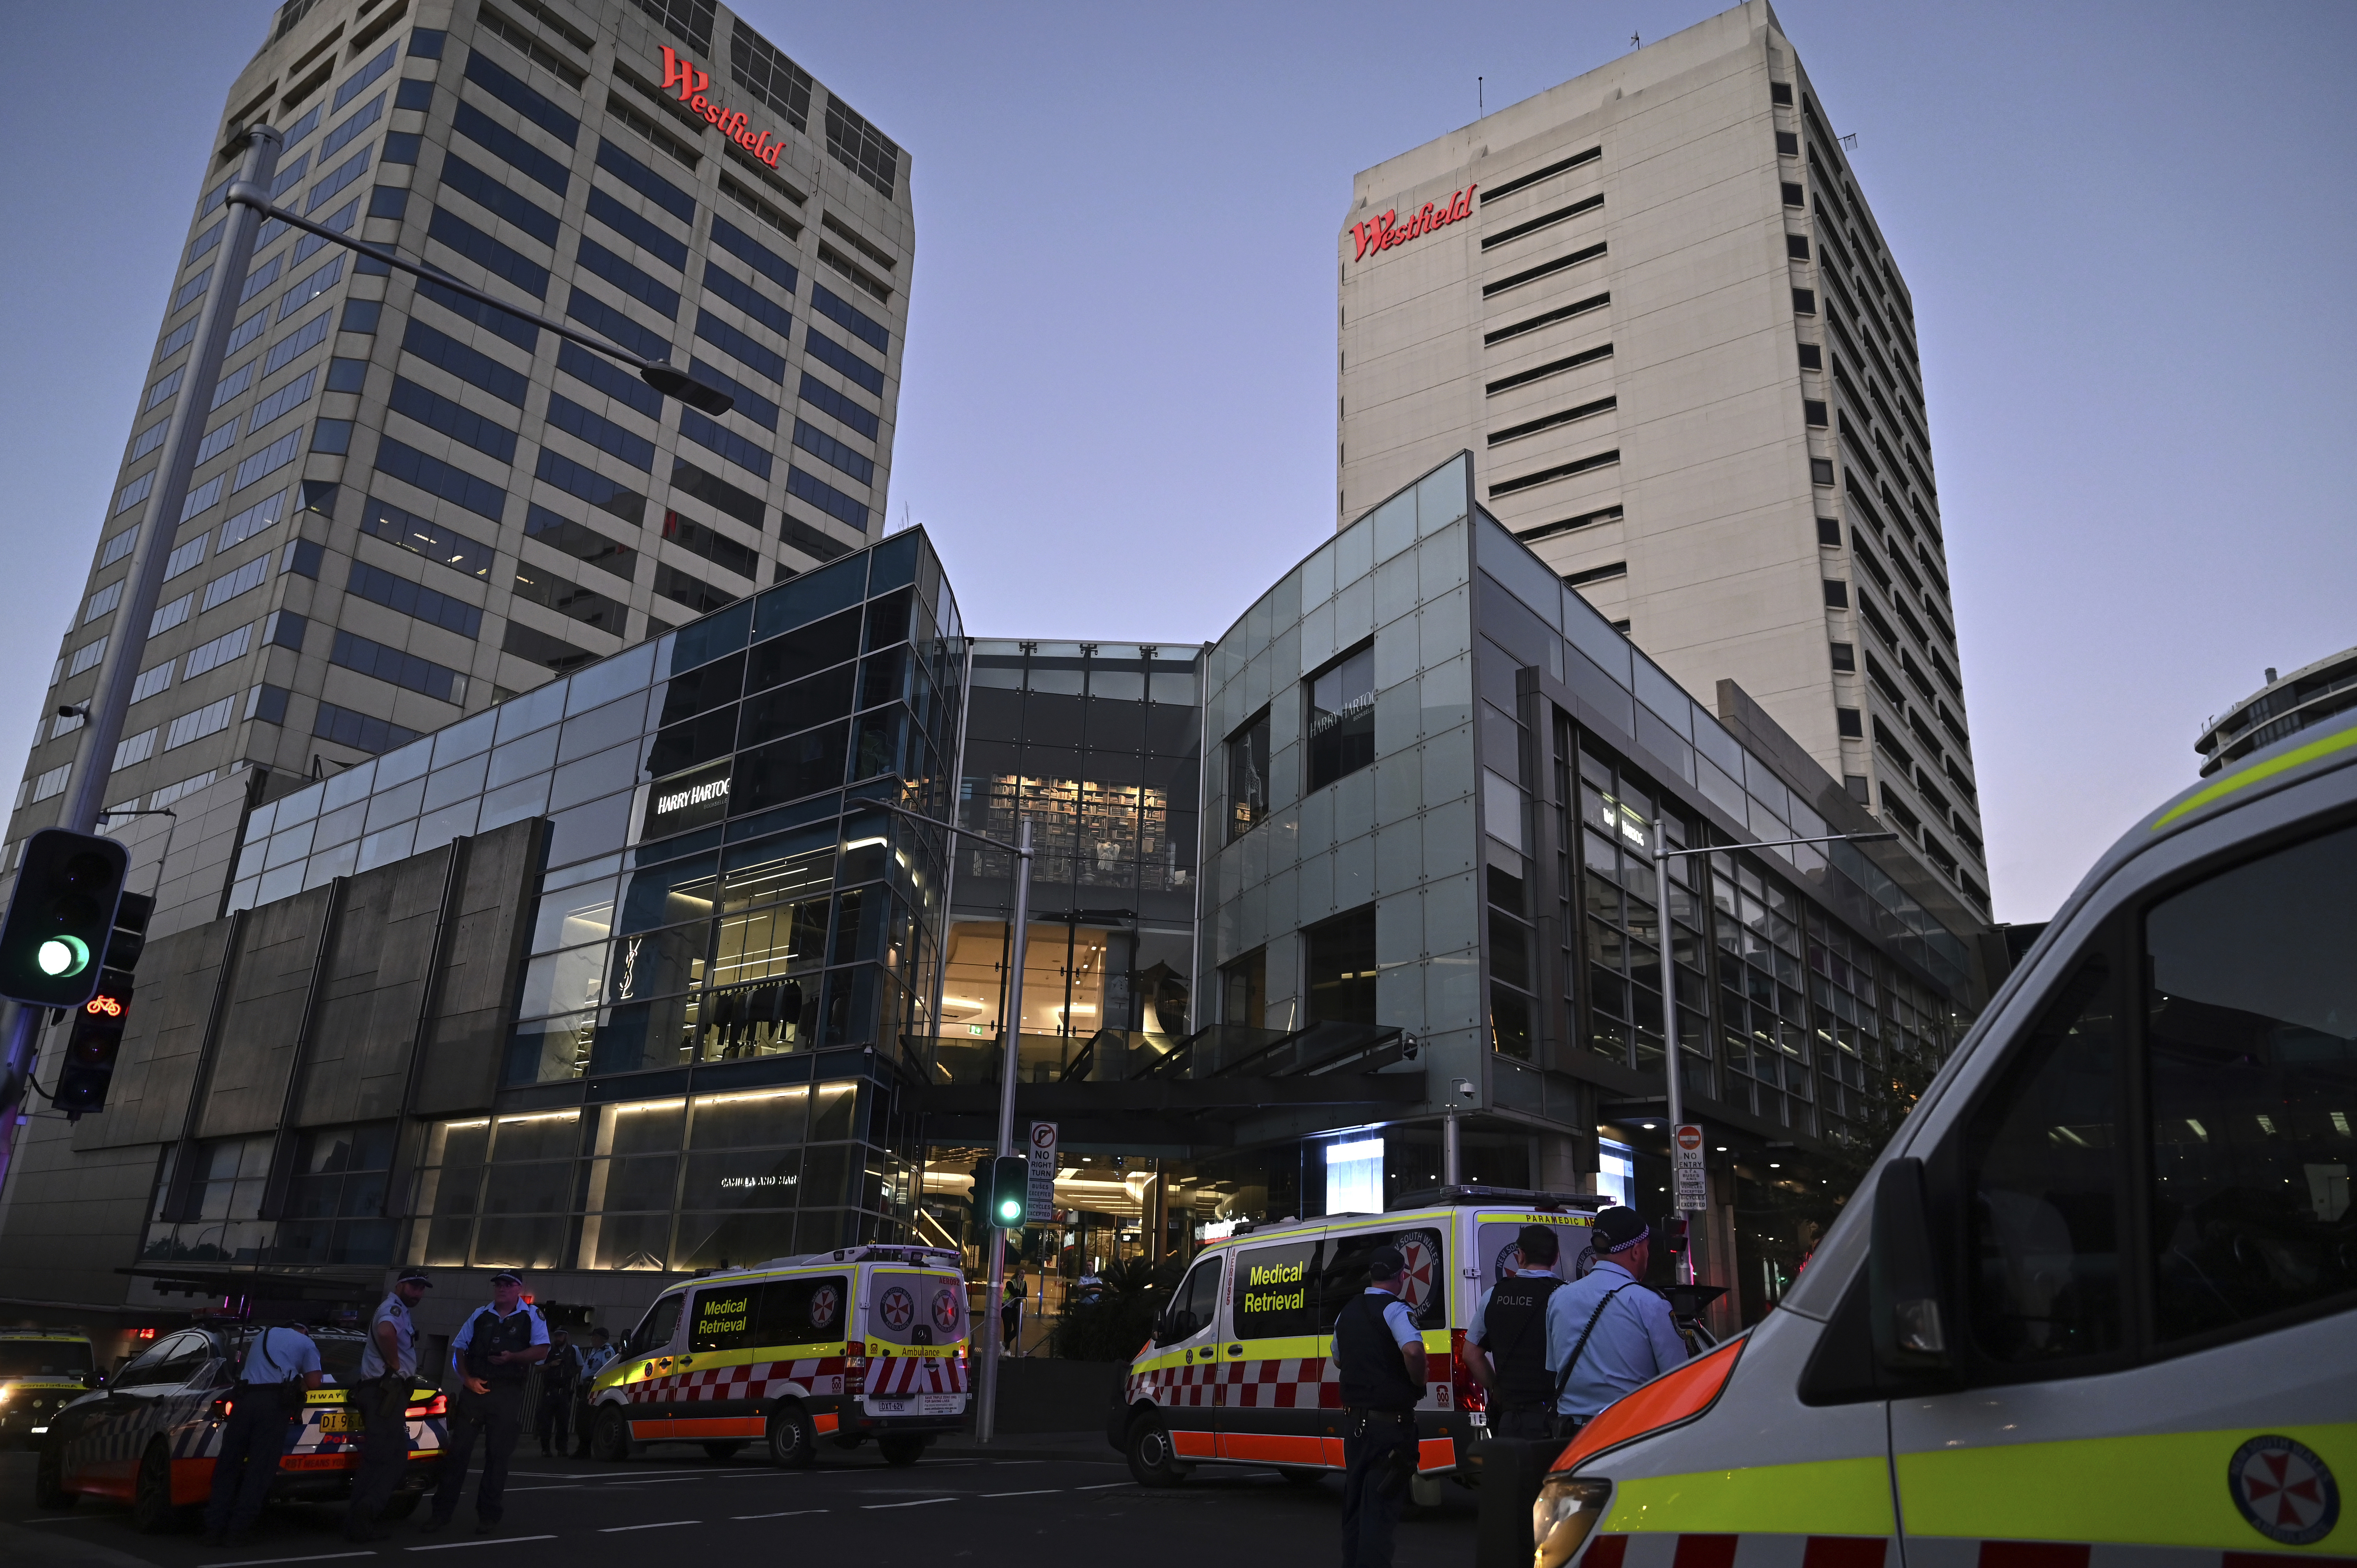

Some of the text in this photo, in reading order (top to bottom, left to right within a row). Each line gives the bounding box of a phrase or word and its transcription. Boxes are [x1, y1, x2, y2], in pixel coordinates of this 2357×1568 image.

[658, 45, 786, 169] Westfield
[1349, 184, 1477, 262] Westfield
[1353, 706, 1375, 721] BOOKSELLE
[1310, 709, 1339, 738] HARRY
[658, 790, 691, 814] HARRY
[704, 798, 728, 809] BOOKSELLE
[1035, 1151, 1049, 1159] NO
[721, 1177, 756, 1187] CAMILLA
[758, 1176, 776, 1185] AND
[1526, 1215, 1579, 1225] PARAMEDIC
[1400, 1232, 1439, 1265] SOUTH WALES
[1496, 1243, 1519, 1268] NEW SOU
[1585, 1247, 1595, 1256] SOU
[1250, 1261, 1303, 1286] Medical
[903, 1289, 912, 1305] WALES
[1244, 1288, 1304, 1313] Retrieval
[1497, 1296, 1533, 1306] POLICE
[704, 1298, 747, 1315] Medical
[699, 1316, 746, 1334] Retrieval
[885, 1321, 910, 1330] AMBULANCE
[902, 1347, 940, 1356] Ambulance
[1437, 1392, 1449, 1402] 000
[2249, 1436, 2290, 1450] SOUTH
[284, 1459, 303, 1468] RBT
[303, 1458, 330, 1468] MEANS
[2251, 1517, 2330, 1544] AMBULANCE
